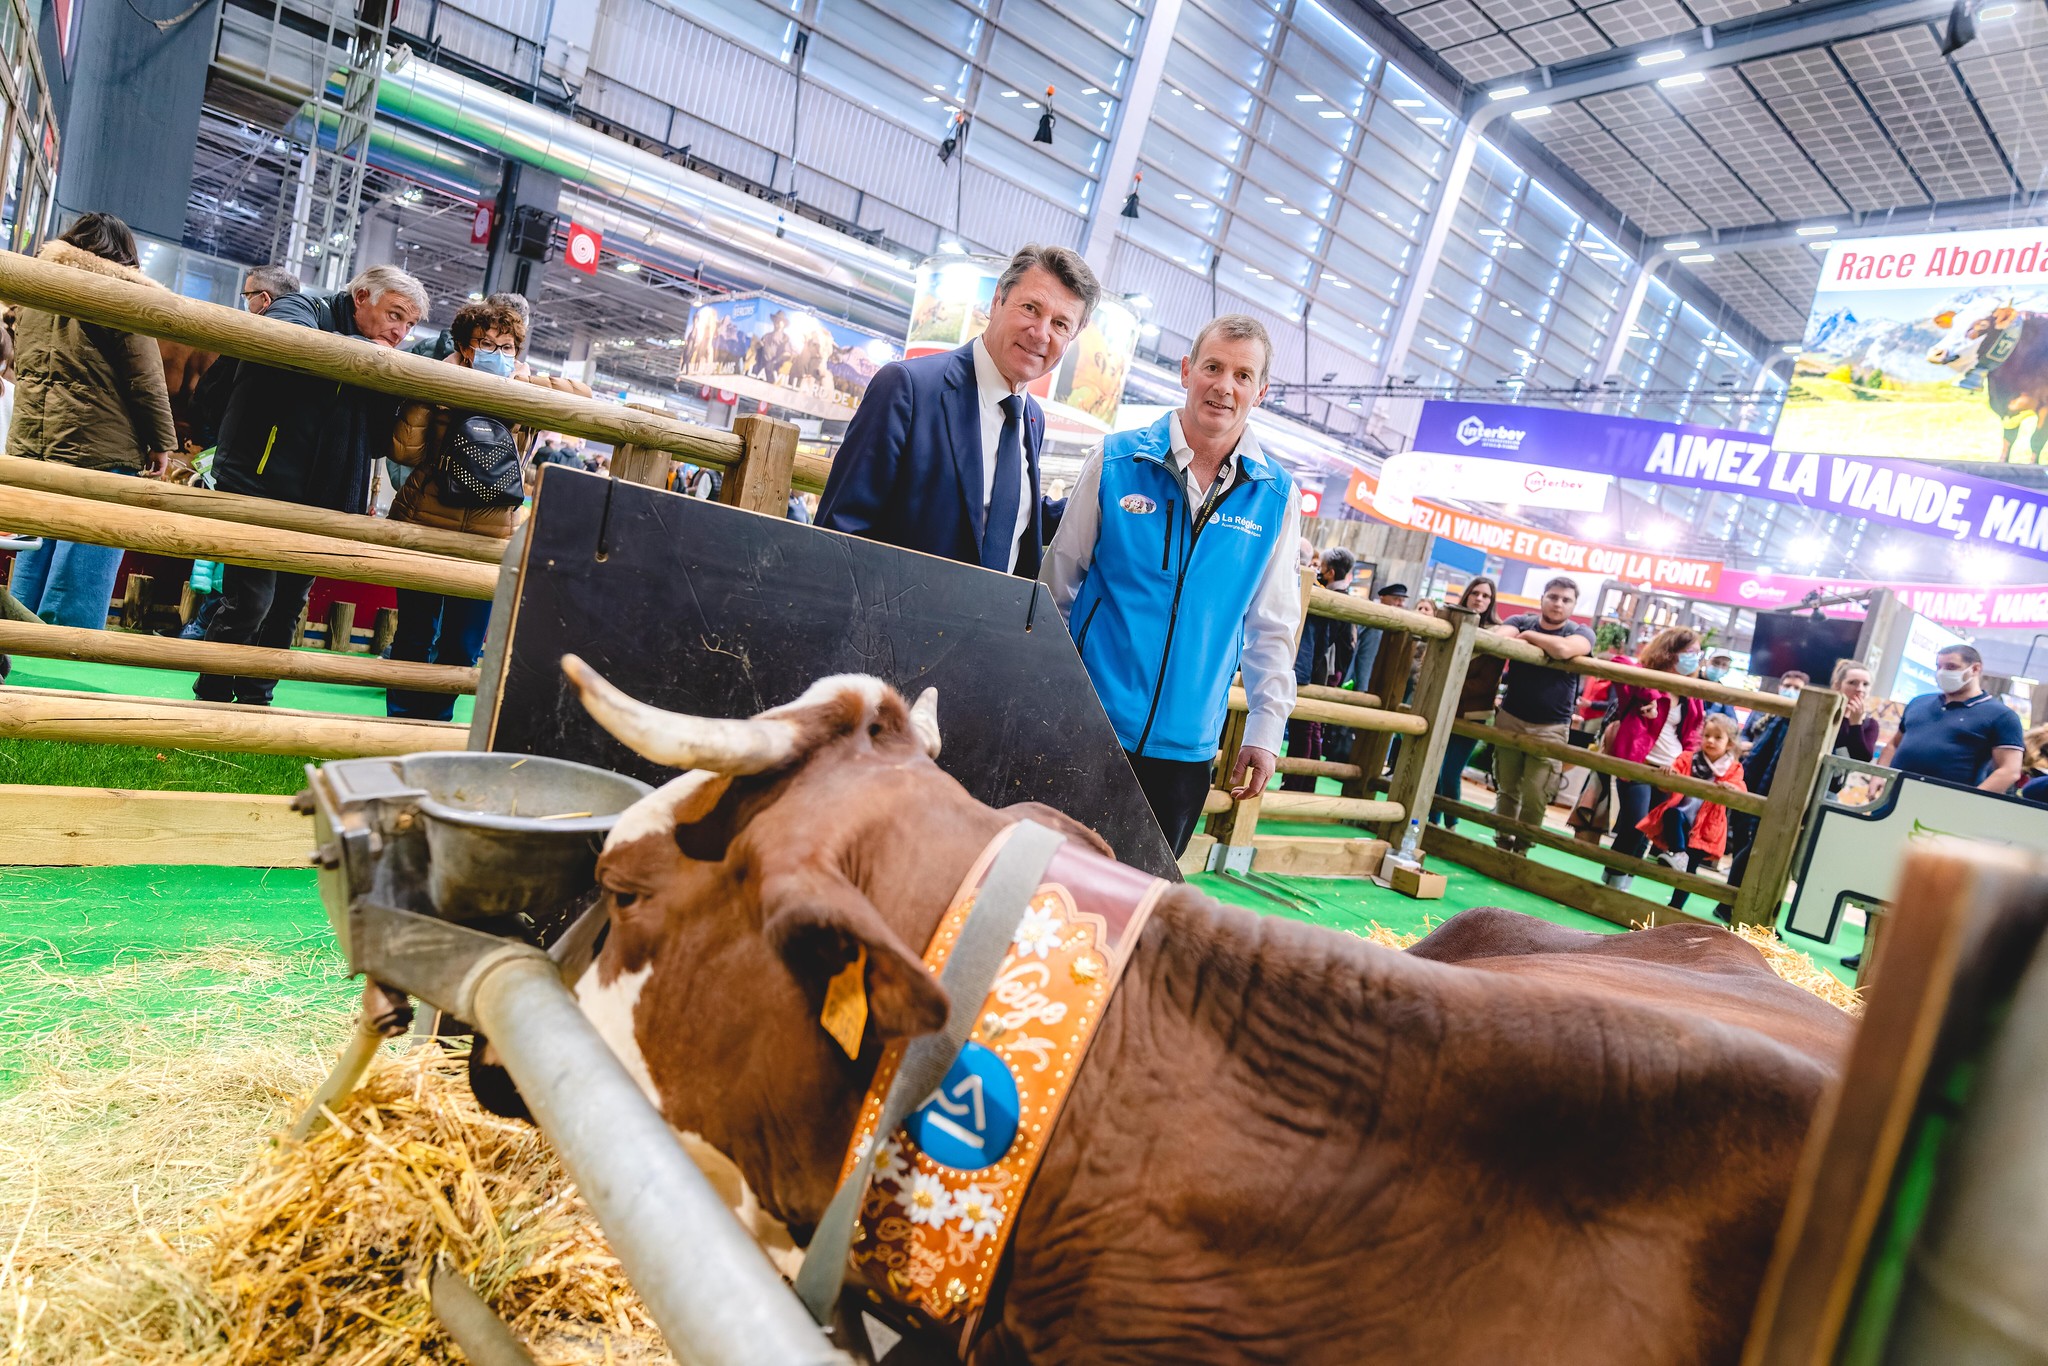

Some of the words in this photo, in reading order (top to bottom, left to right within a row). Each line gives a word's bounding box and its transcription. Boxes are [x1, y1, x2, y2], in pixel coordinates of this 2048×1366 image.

[1836, 252, 1917, 281] Race
[832, 389, 851, 406] DE
[1463, 423, 1526, 441] interbev
[1644, 432, 1771, 487] AIMEZ
[1768, 453, 1820, 498] LA
[1828, 457, 1972, 541] VIANDE,
[1221, 513, 1233, 523] La
[1234, 515, 1263, 532] Région
[1432, 511, 1451, 537] LA
[1453, 517, 1515, 551] VIANDE
[1513, 531, 1539, 556] ET
[1587, 548, 1626, 575] QUI
[1625, 554, 1651, 580] LA
[1653, 559, 1712, 588] FONT.
[1911, 590, 1988, 628] VIANDE,
